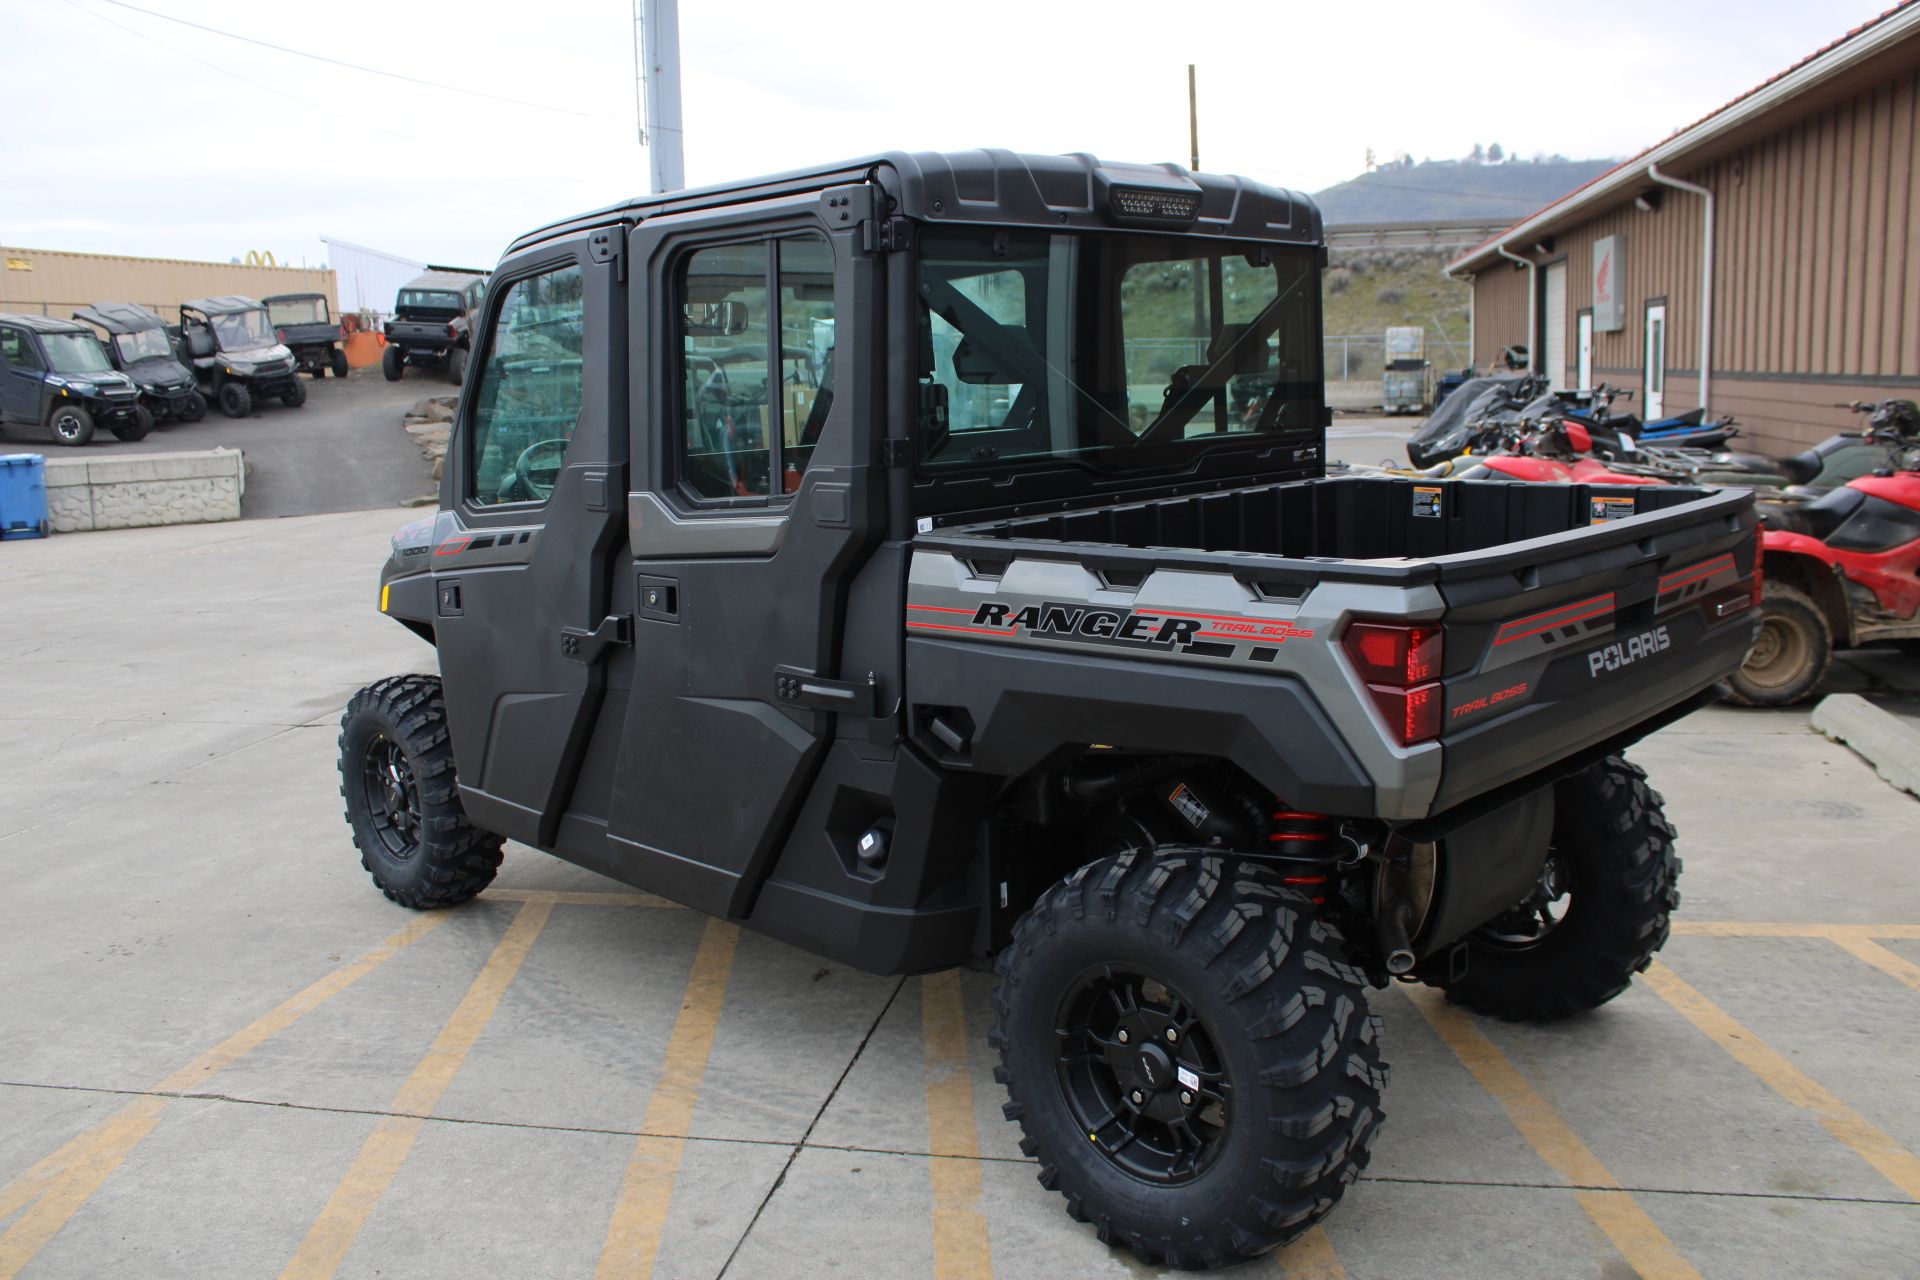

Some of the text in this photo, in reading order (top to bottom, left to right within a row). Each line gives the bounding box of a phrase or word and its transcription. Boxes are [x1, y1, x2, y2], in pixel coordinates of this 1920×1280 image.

[402, 545, 429, 557] 1000
[973, 602, 1202, 646] RANGER
[1211, 621, 1314, 639] TRAIL BOSS
[1589, 626, 1671, 678] POLARIS
[1453, 683, 1528, 718] TRAIL BOSS
